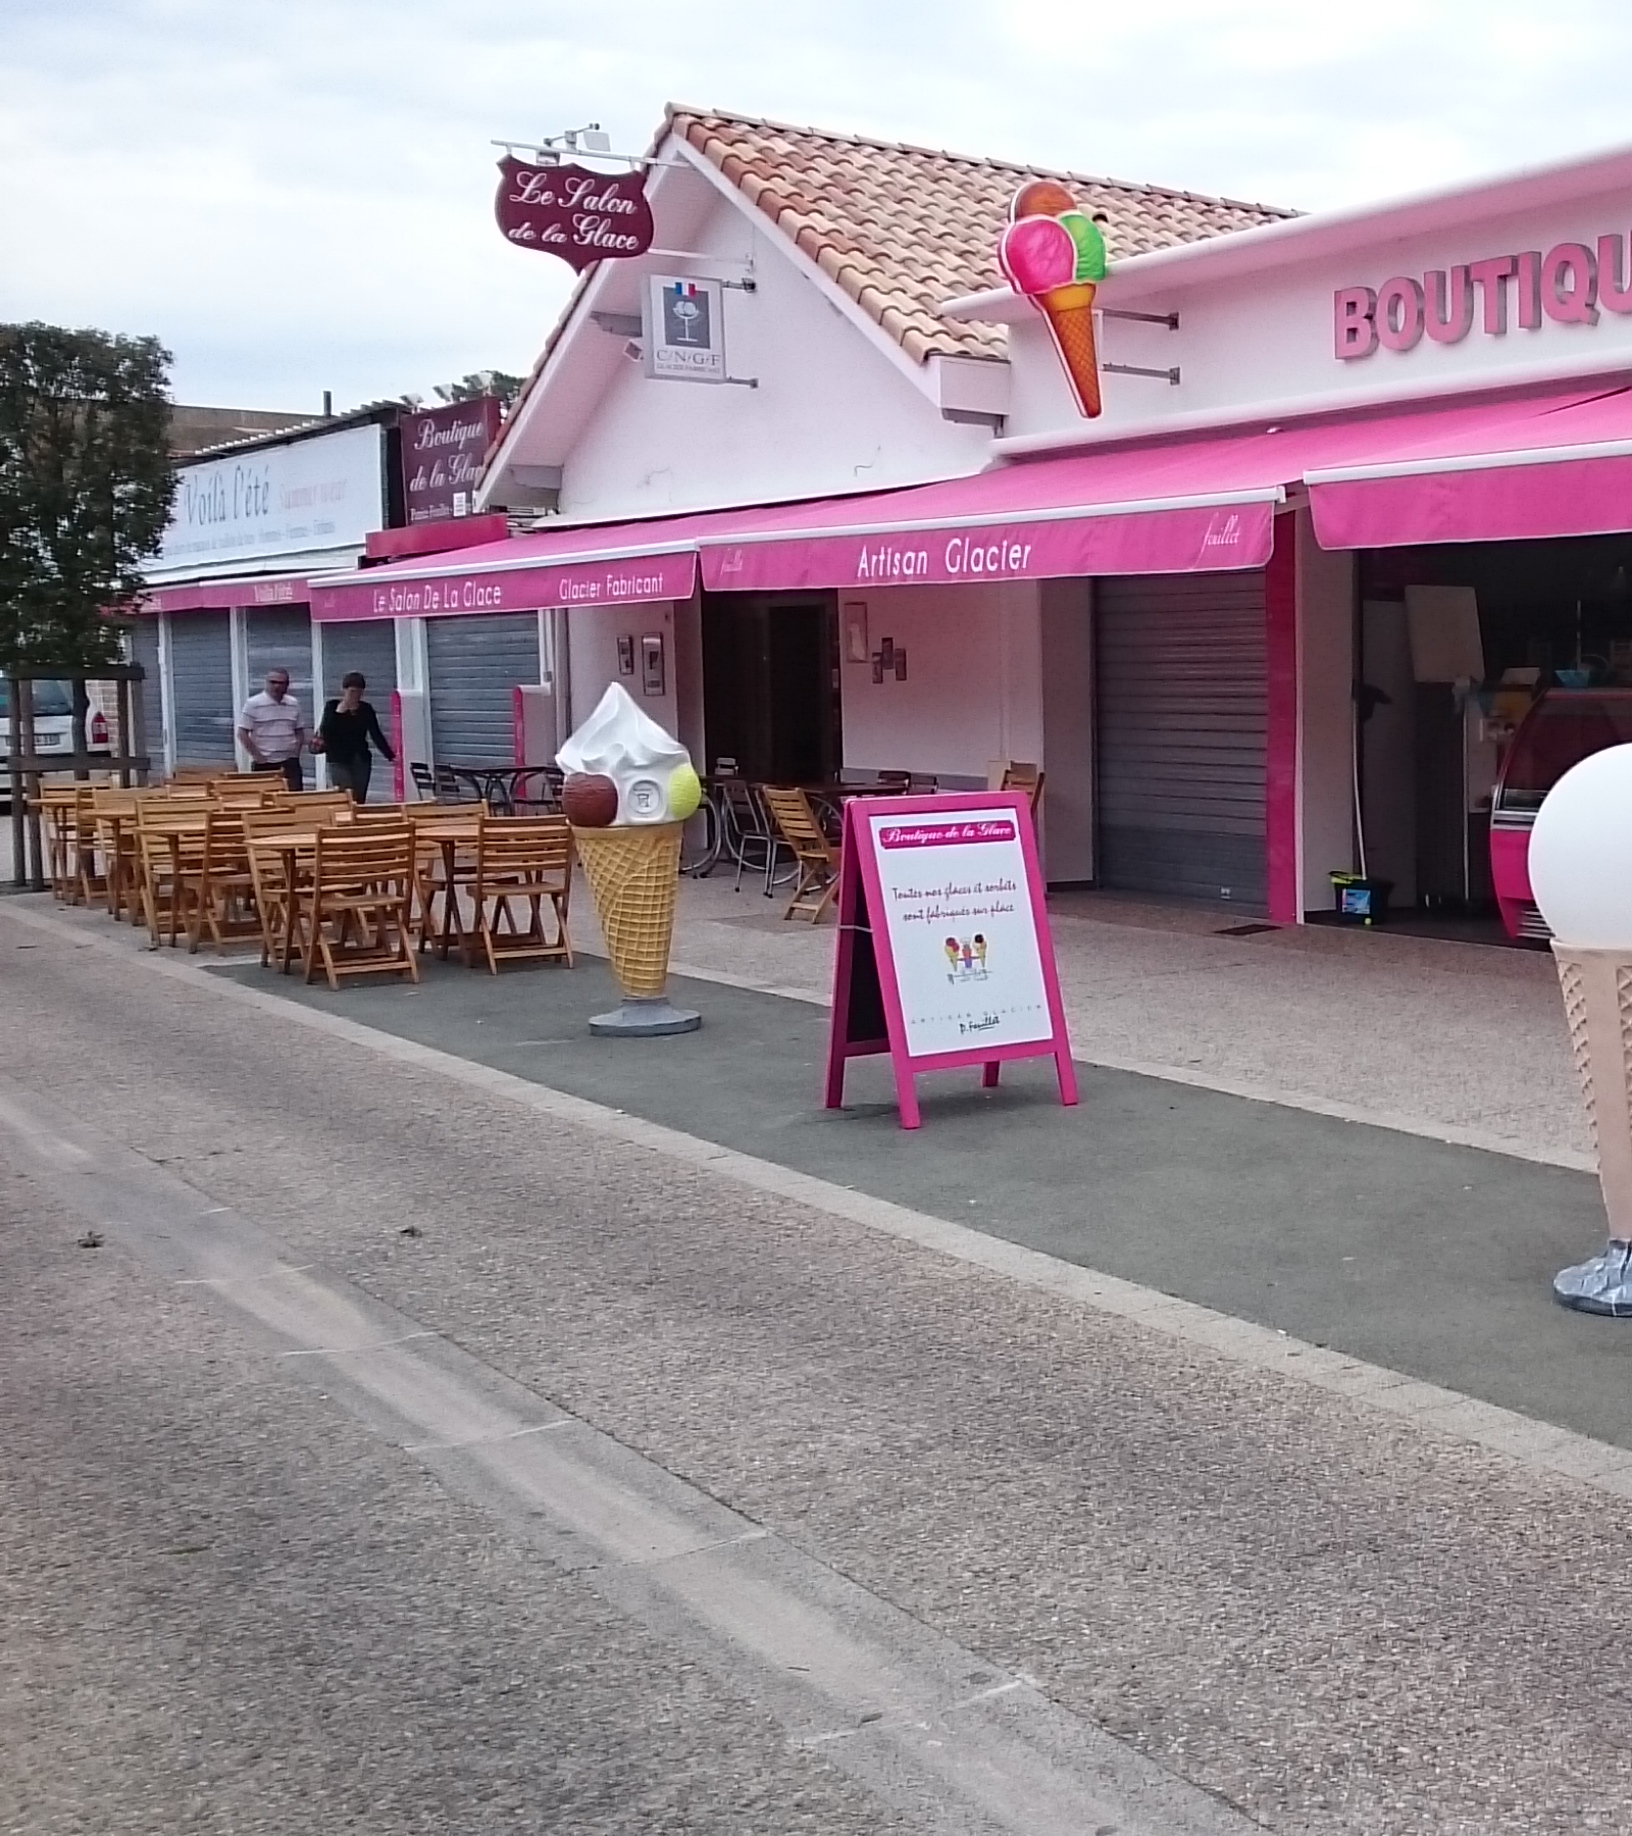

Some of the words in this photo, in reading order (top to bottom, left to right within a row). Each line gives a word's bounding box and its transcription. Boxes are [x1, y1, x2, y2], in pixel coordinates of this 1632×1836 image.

[509, 171, 555, 205] Le
[558, 177, 638, 214] Salon
[508, 222, 536, 240] de
[542, 223, 567, 243] la
[572, 213, 639, 250] Glace
[413, 418, 484, 450] Boutique
[409, 465, 427, 493] de
[430, 459, 445, 488] la
[448, 452, 485, 485] Glac
[857, 544, 928, 578] Artisan
[945, 537, 1032, 574] Glacier
[373, 588, 386, 613] Le
[389, 586, 420, 612] Salon
[423, 584, 440, 609] De
[444, 582, 458, 608] La
[463, 581, 501, 607] Glace
[559, 578, 601, 600] Glacier
[606, 572, 664, 596] Fabricant
[883, 828, 943, 844] Boutique
[945, 826, 960, 839] de
[962, 825, 975, 837] la
[977, 822, 1012, 837] Glace
[892, 887, 922, 901] Toutes
[925, 888, 942, 897] nos
[944, 881, 971, 902] glaces
[973, 882, 982, 893] et
[985, 878, 1017, 892] sorbets
[903, 909, 924, 922] sont
[972, 907, 988, 915] sur
[990, 900, 1015, 917] place
